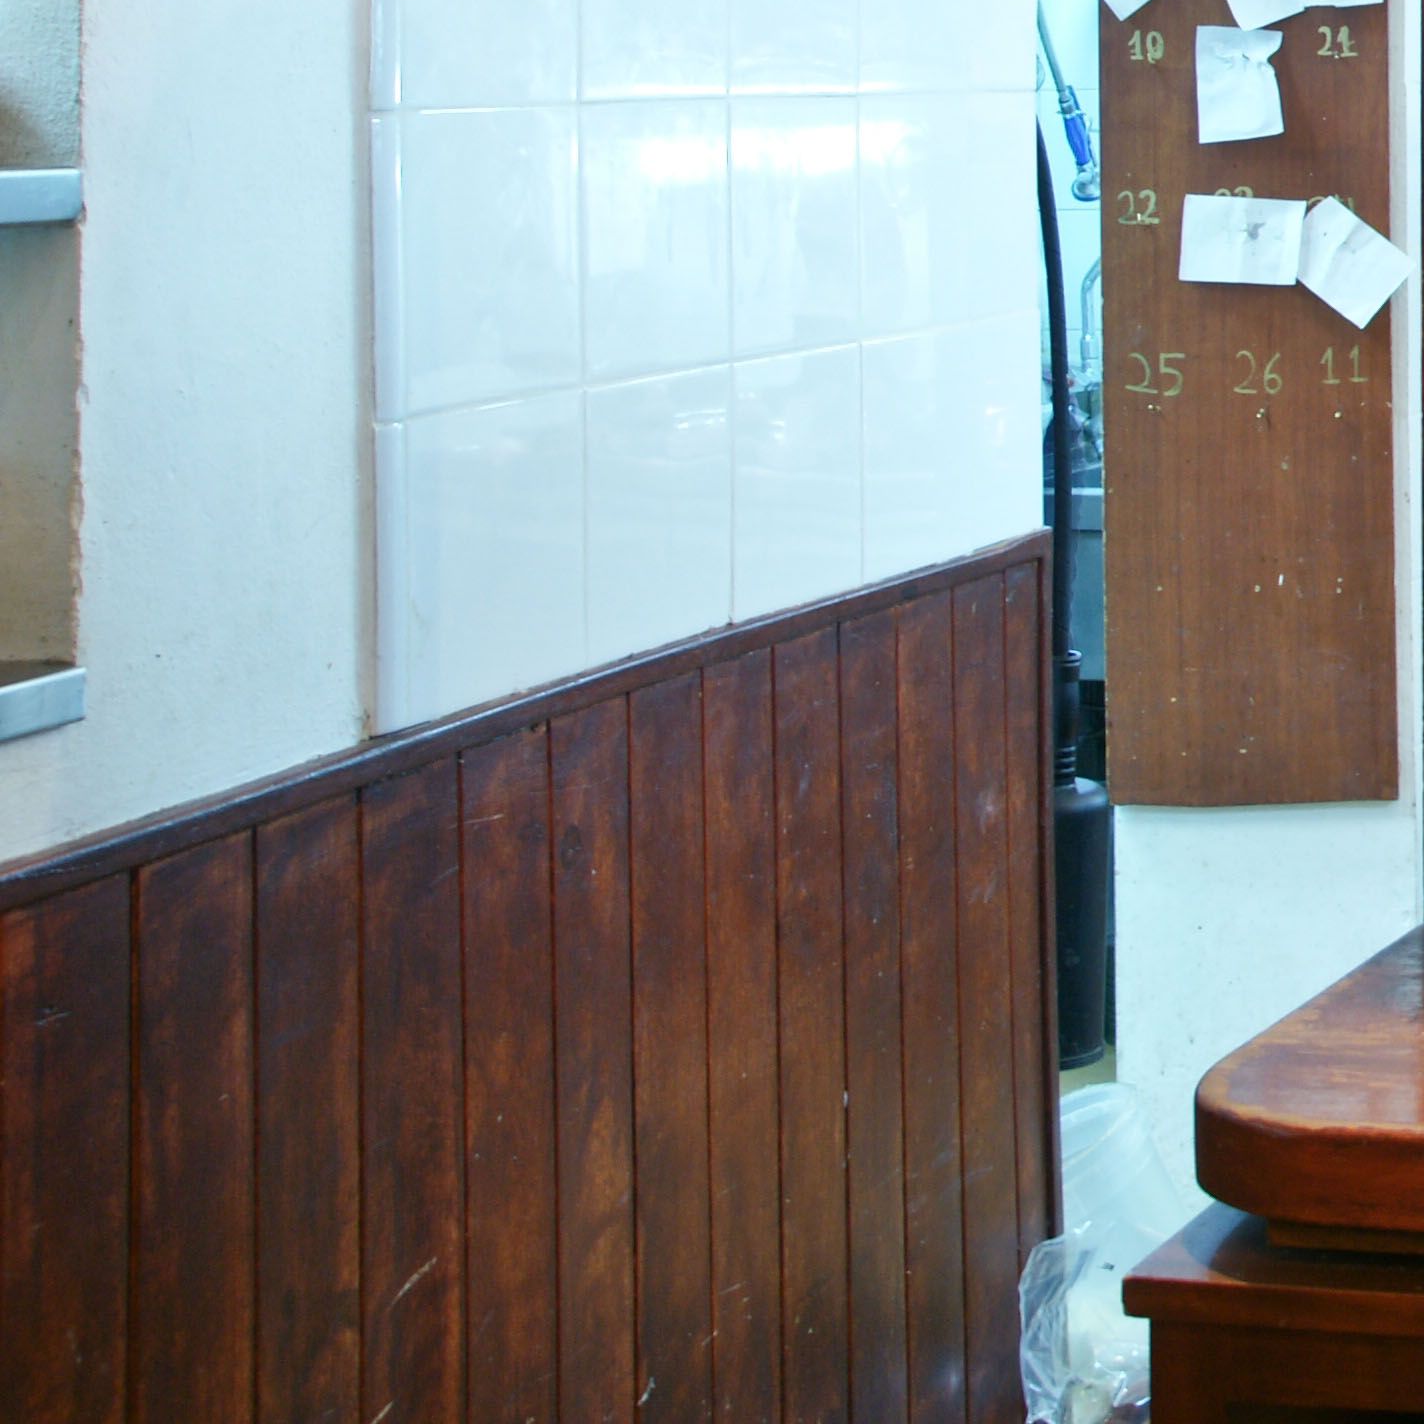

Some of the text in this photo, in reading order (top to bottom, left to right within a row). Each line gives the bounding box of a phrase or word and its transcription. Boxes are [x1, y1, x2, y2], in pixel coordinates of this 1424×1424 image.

[1117, 189, 1161, 225] 22
[1124, 345, 1369, 396] 25 26 11
